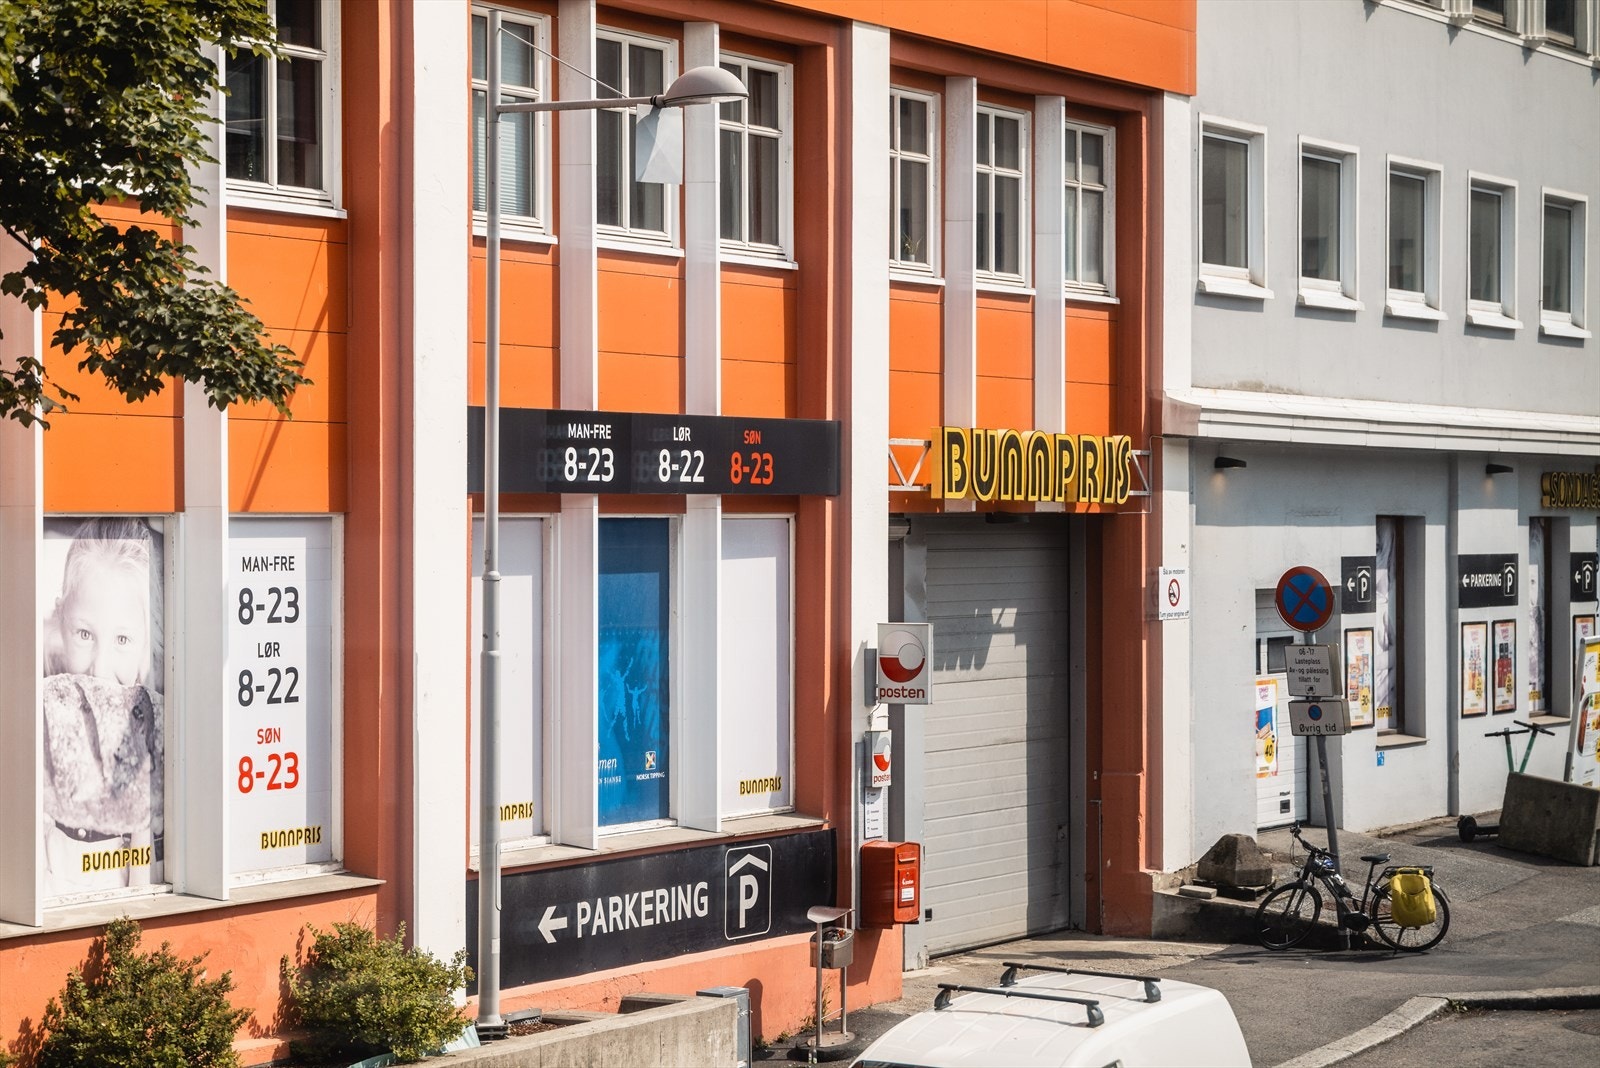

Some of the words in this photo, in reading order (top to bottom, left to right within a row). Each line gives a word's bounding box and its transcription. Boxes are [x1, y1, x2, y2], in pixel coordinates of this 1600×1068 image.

[568, 423, 612, 441] MAN-FRE
[673, 426, 691, 443] LØR
[743, 430, 761, 445] SØN
[564, 446, 615, 483] 8-23
[658, 449, 705, 484] 8-22
[730, 451, 775, 486] 8-23
[942, 426, 1132, 505] BUNNPRIS
[242, 556, 296, 573] MAN-FRE
[1470, 573, 1502, 588] PARKERING
[237, 586, 300, 626] 8-23
[257, 642, 281, 659] LØR
[237, 667, 300, 707] 8-22
[879, 686, 925, 701] posten
[256, 727, 282, 745] SØN
[1299, 723, 1321, 734] Øvrig
[1325, 724, 1336, 732] tid
[237, 752, 300, 794] 8-23
[739, 775, 783, 797] BUNNPRIS
[260, 825, 322, 850] BUNNPRIS
[81, 846, 152, 873] BUNNPRIS
[576, 881, 710, 939] PARKERING
[738, 873, 759, 930] P
